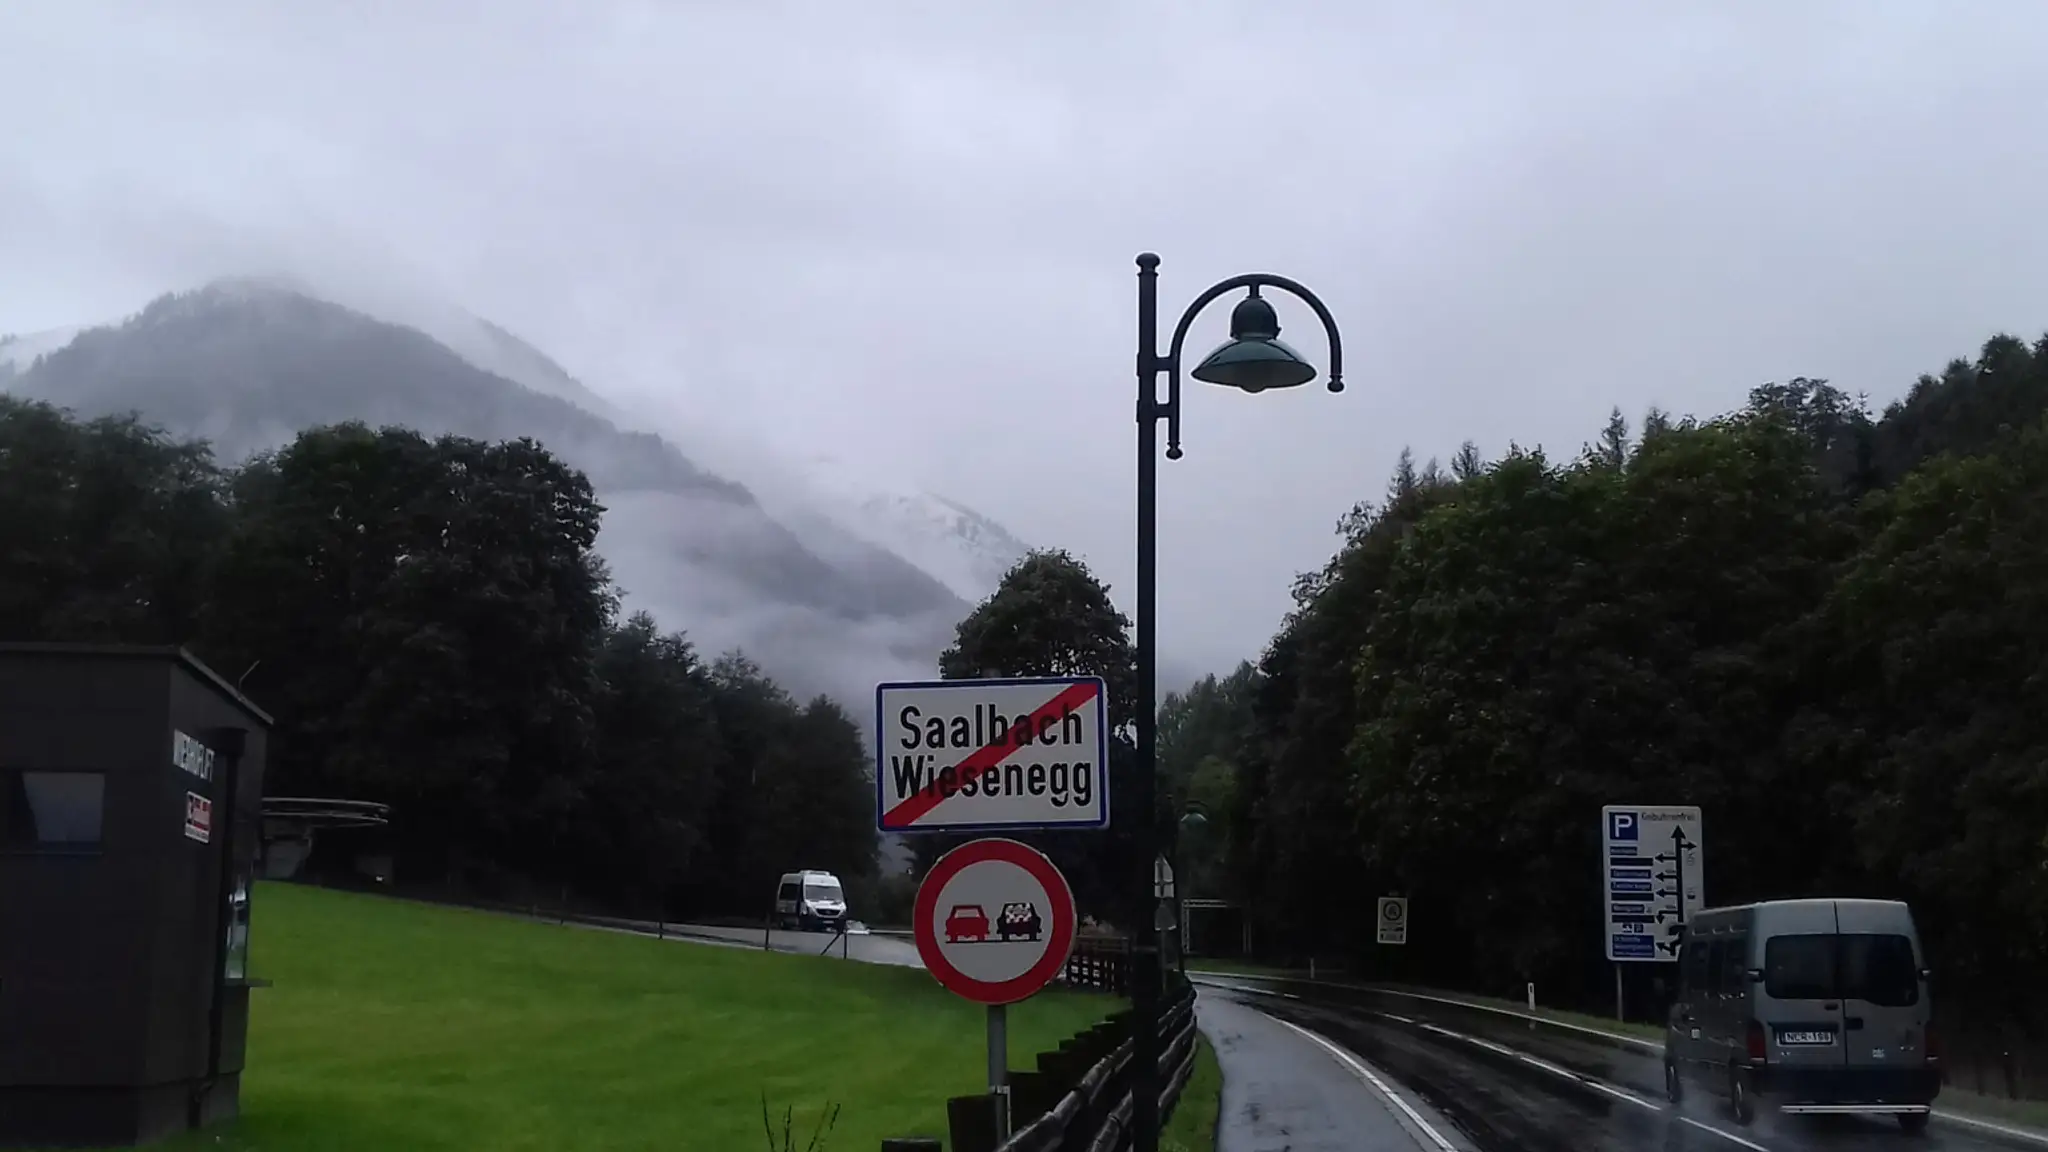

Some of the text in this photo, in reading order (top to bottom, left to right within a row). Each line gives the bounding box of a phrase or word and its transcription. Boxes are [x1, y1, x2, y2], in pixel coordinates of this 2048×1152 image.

[900, 703, 1083, 749] Saalbach
[891, 755, 1092, 807] Wiesenegg
[1614, 814, 1633, 838] P
